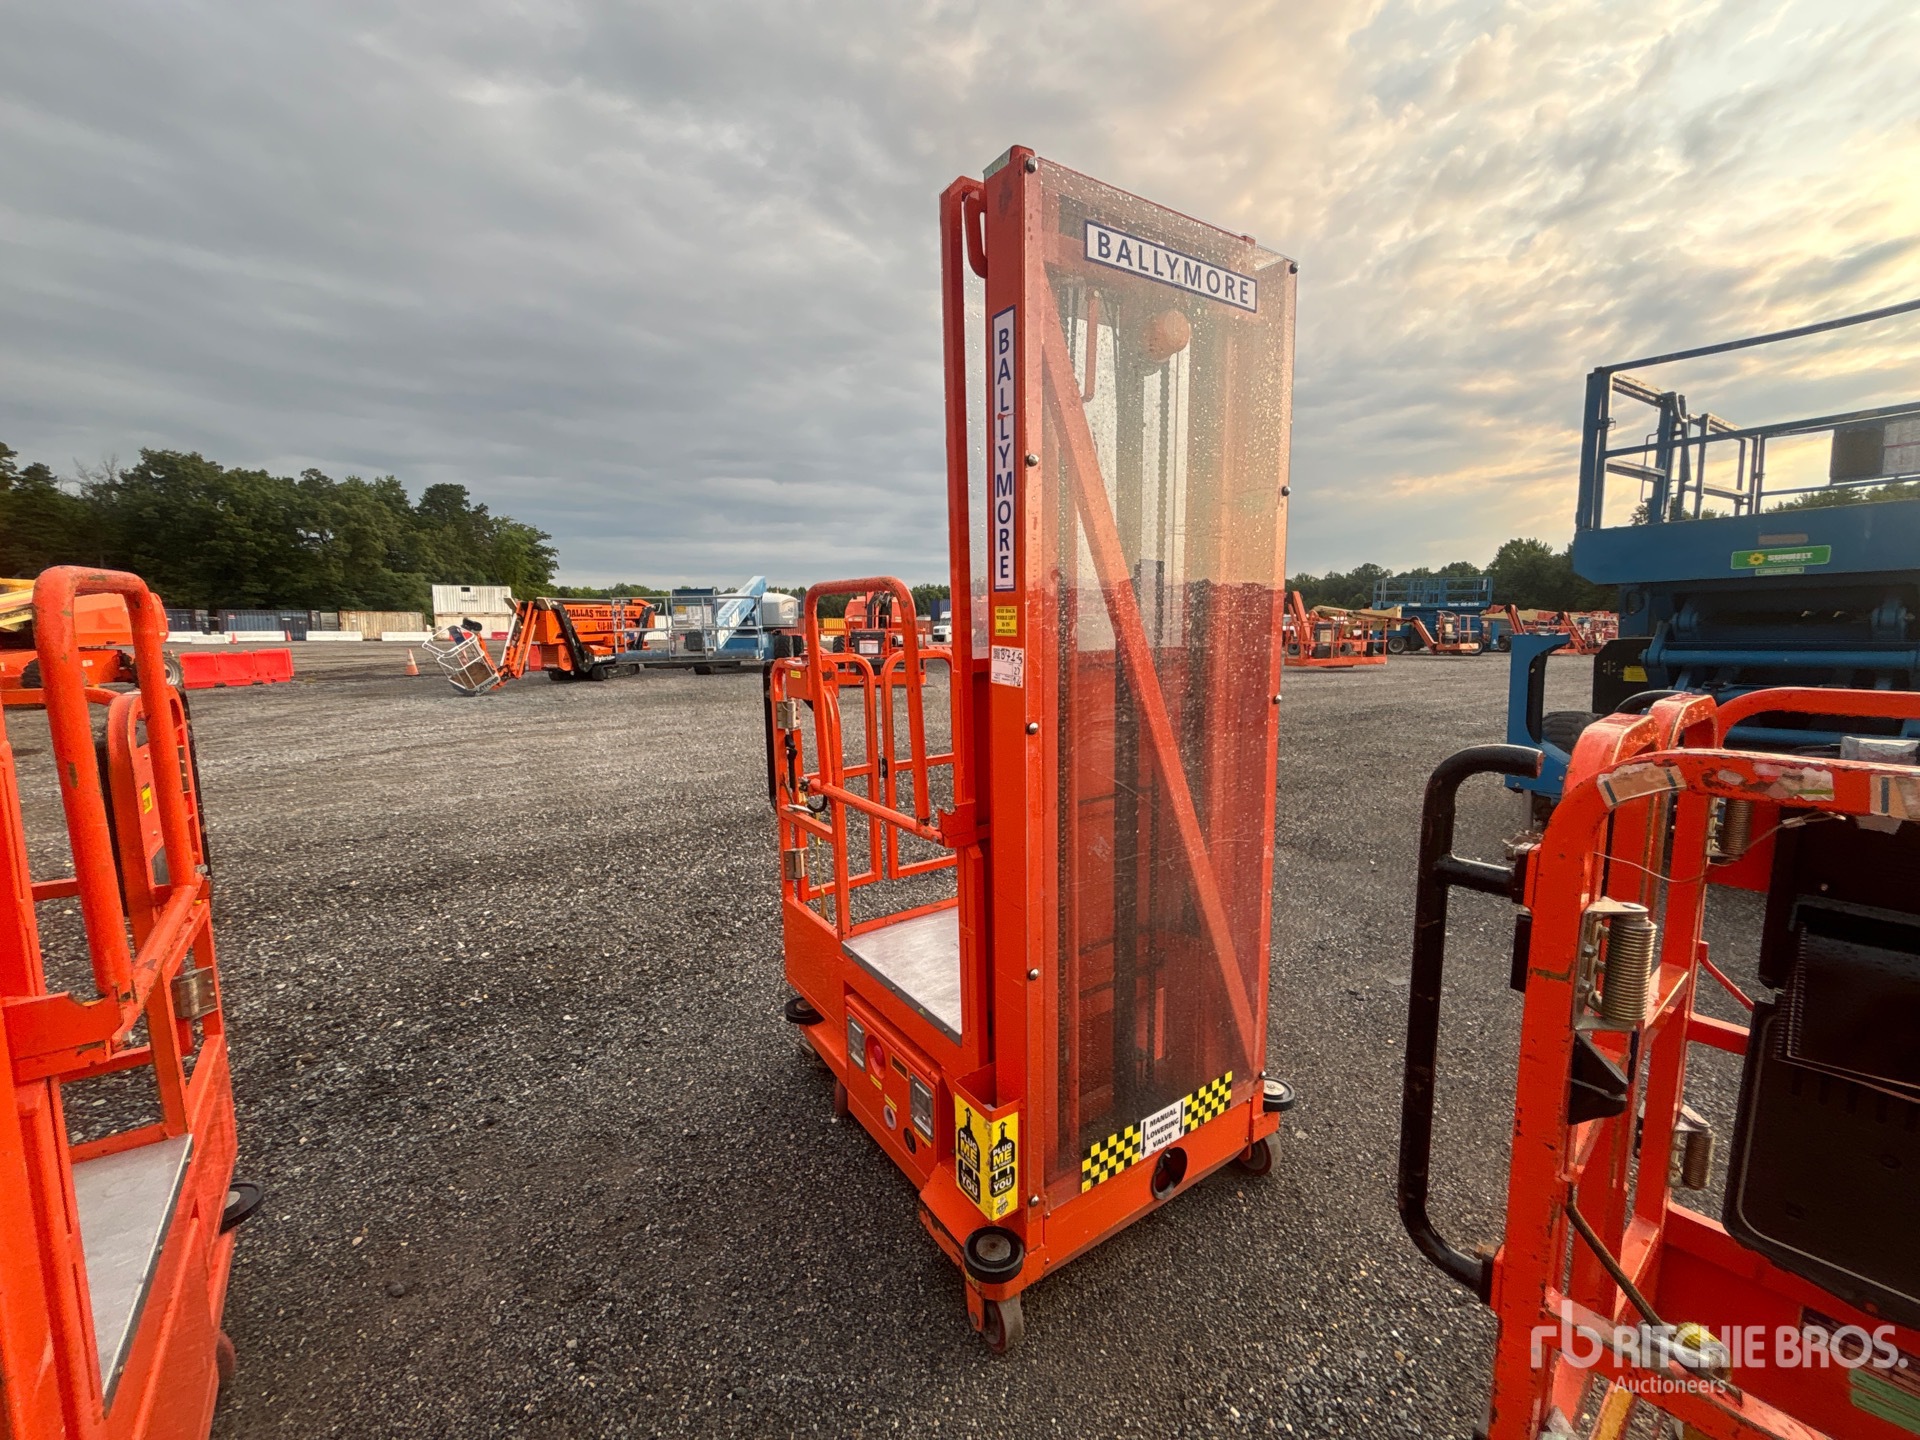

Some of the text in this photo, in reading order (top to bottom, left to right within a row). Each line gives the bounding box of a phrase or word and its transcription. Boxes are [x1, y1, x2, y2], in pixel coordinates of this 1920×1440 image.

[1097, 230, 1249, 305] BALLYMORE
[996, 327, 1013, 579] BALLYMORE
[567, 608, 594, 618] DALLAS
[595, 609, 609, 618] TREE
[1149, 1107, 1178, 1128] MANUAL
[1146, 1117, 1180, 1141] LOWERING
[960, 1130, 978, 1150] PLUG
[992, 1142, 1013, 1156] PLUG
[1152, 1132, 1173, 1149] VALVE
[961, 1138, 978, 1166] ME
[993, 1149, 1012, 1167] ME
[961, 1172, 978, 1196] YOU
[993, 1176, 1013, 1192] YOU
